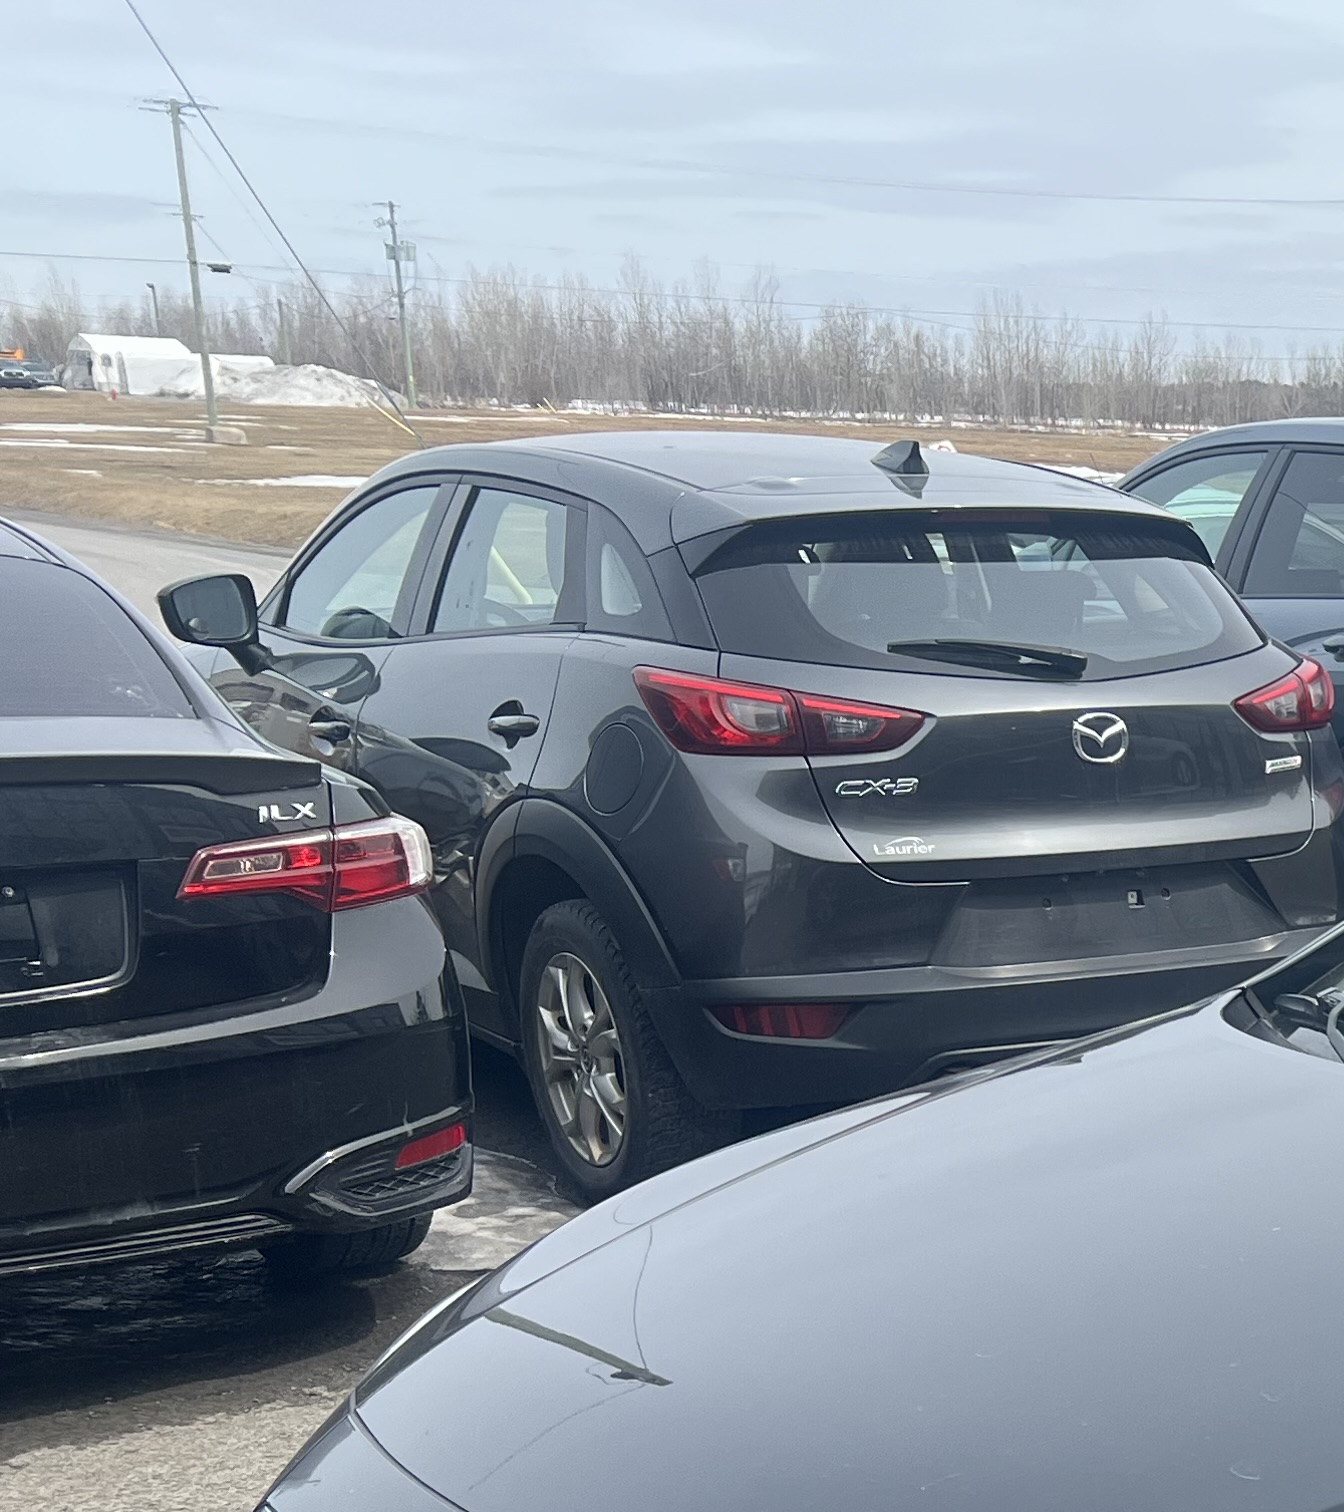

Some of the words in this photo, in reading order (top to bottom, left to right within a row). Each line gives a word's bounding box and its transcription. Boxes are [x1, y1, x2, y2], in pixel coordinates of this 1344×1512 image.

[835, 777, 919, 797] CX-3
[258, 802, 317, 823] ILX
[873, 842, 936, 855] Laurier
